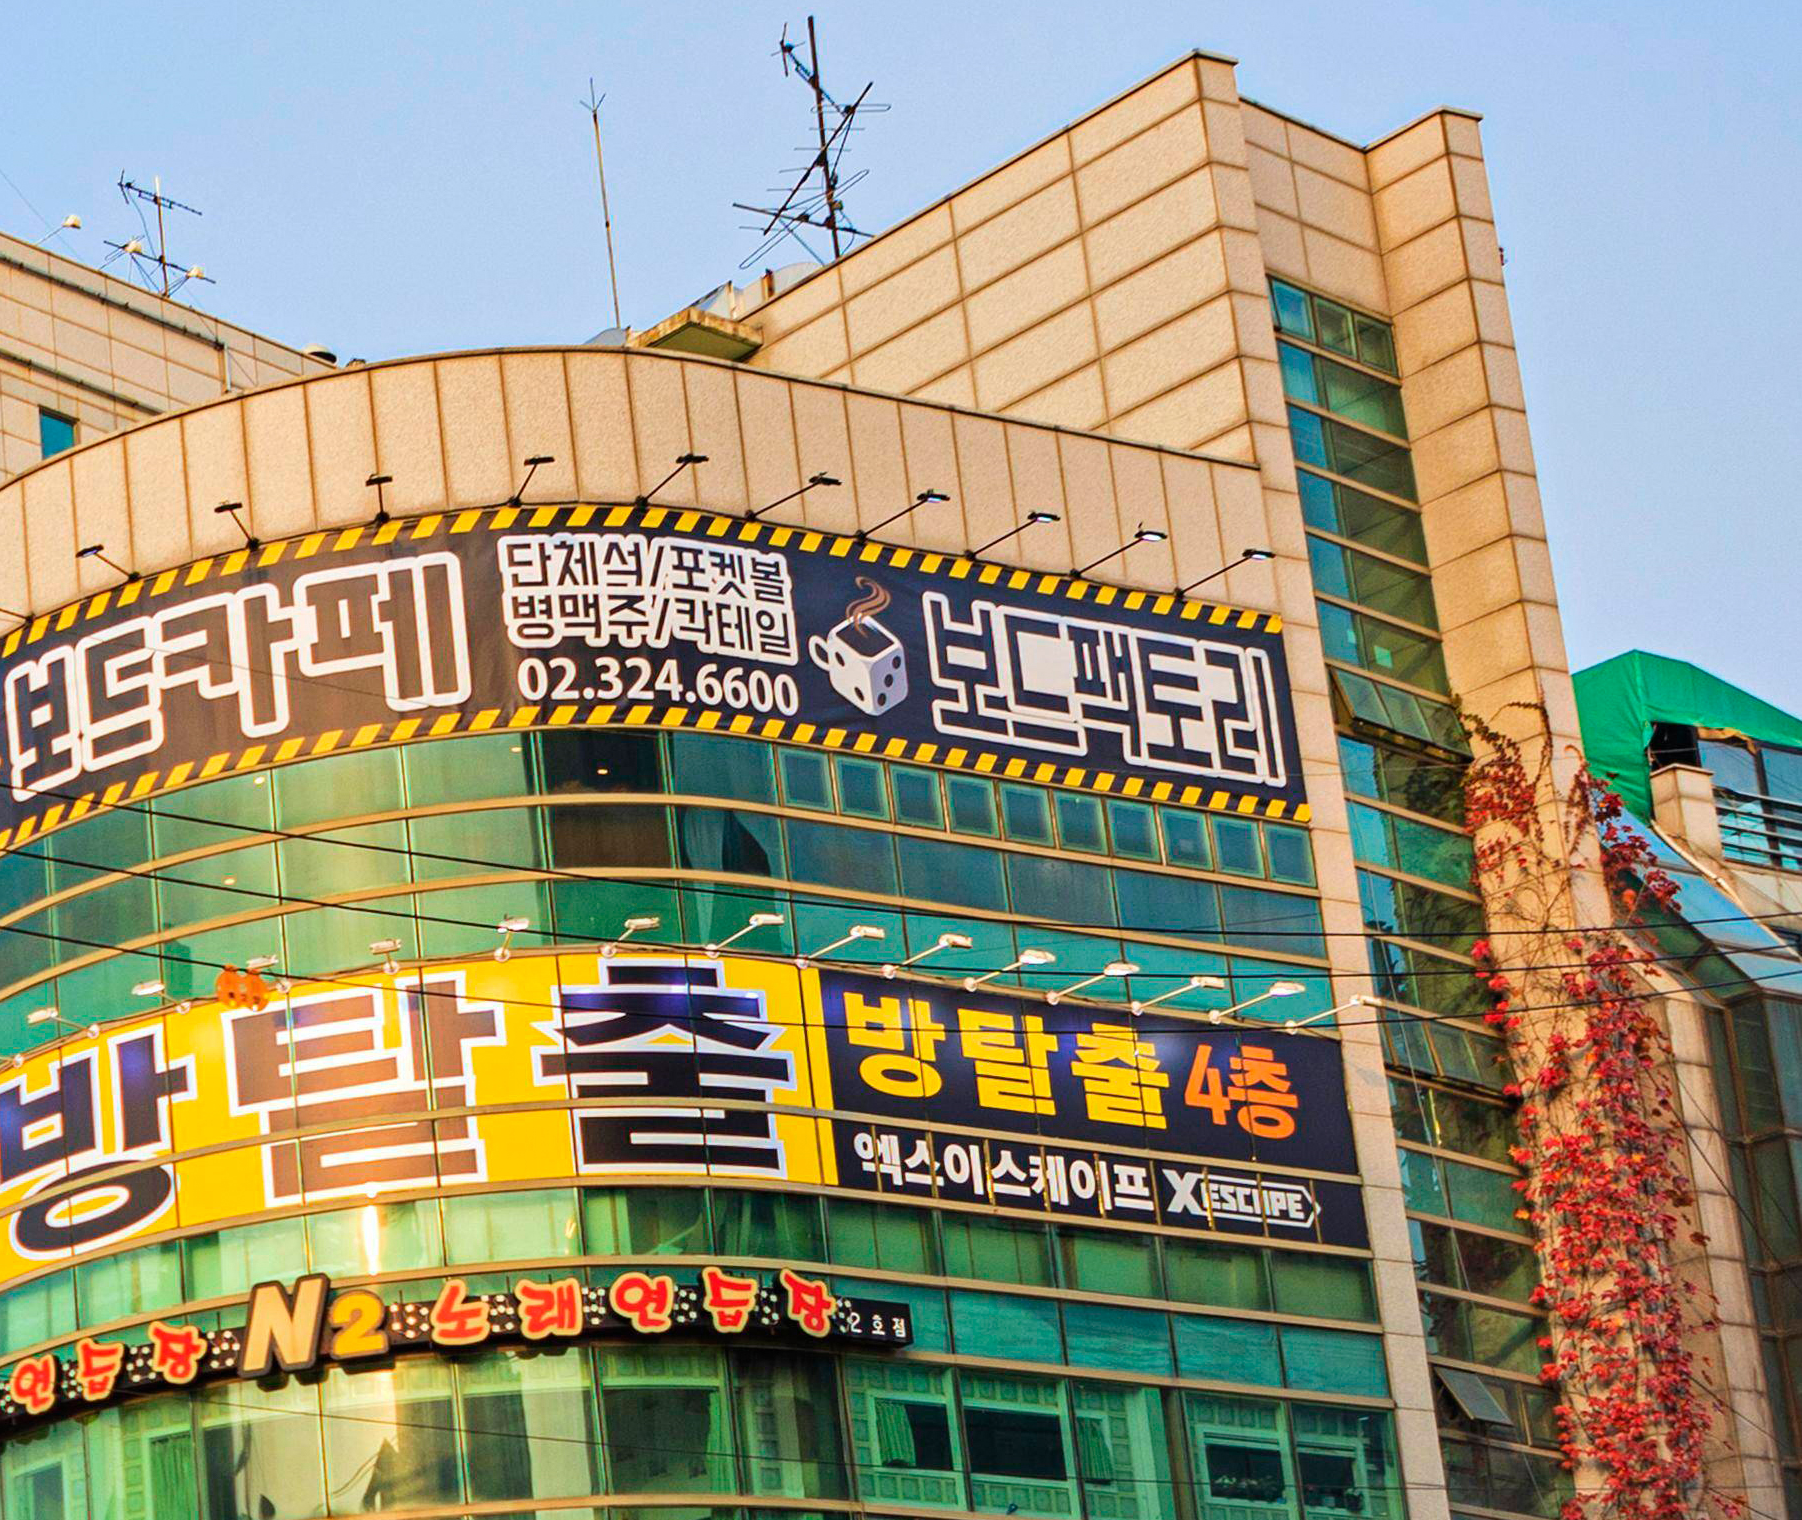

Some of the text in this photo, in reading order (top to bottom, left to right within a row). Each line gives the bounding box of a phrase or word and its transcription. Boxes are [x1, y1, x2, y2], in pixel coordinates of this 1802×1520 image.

[501, 536, 789, 606] 단체석/포켓볼
[4, 551, 471, 802] 보드카페
[517, 656, 798, 716] 02.324.6600
[922, 591, 1286, 788] 보드팩토리
[843, 991, 1299, 1139] 방탈출 4층
[854, 1131, 1155, 1217] 엑스이스케이프
[239, 1275, 389, 1377] N2
[431, 1266, 837, 1347] 노래연습장
[849, 1312, 907, 1339] 2호점
